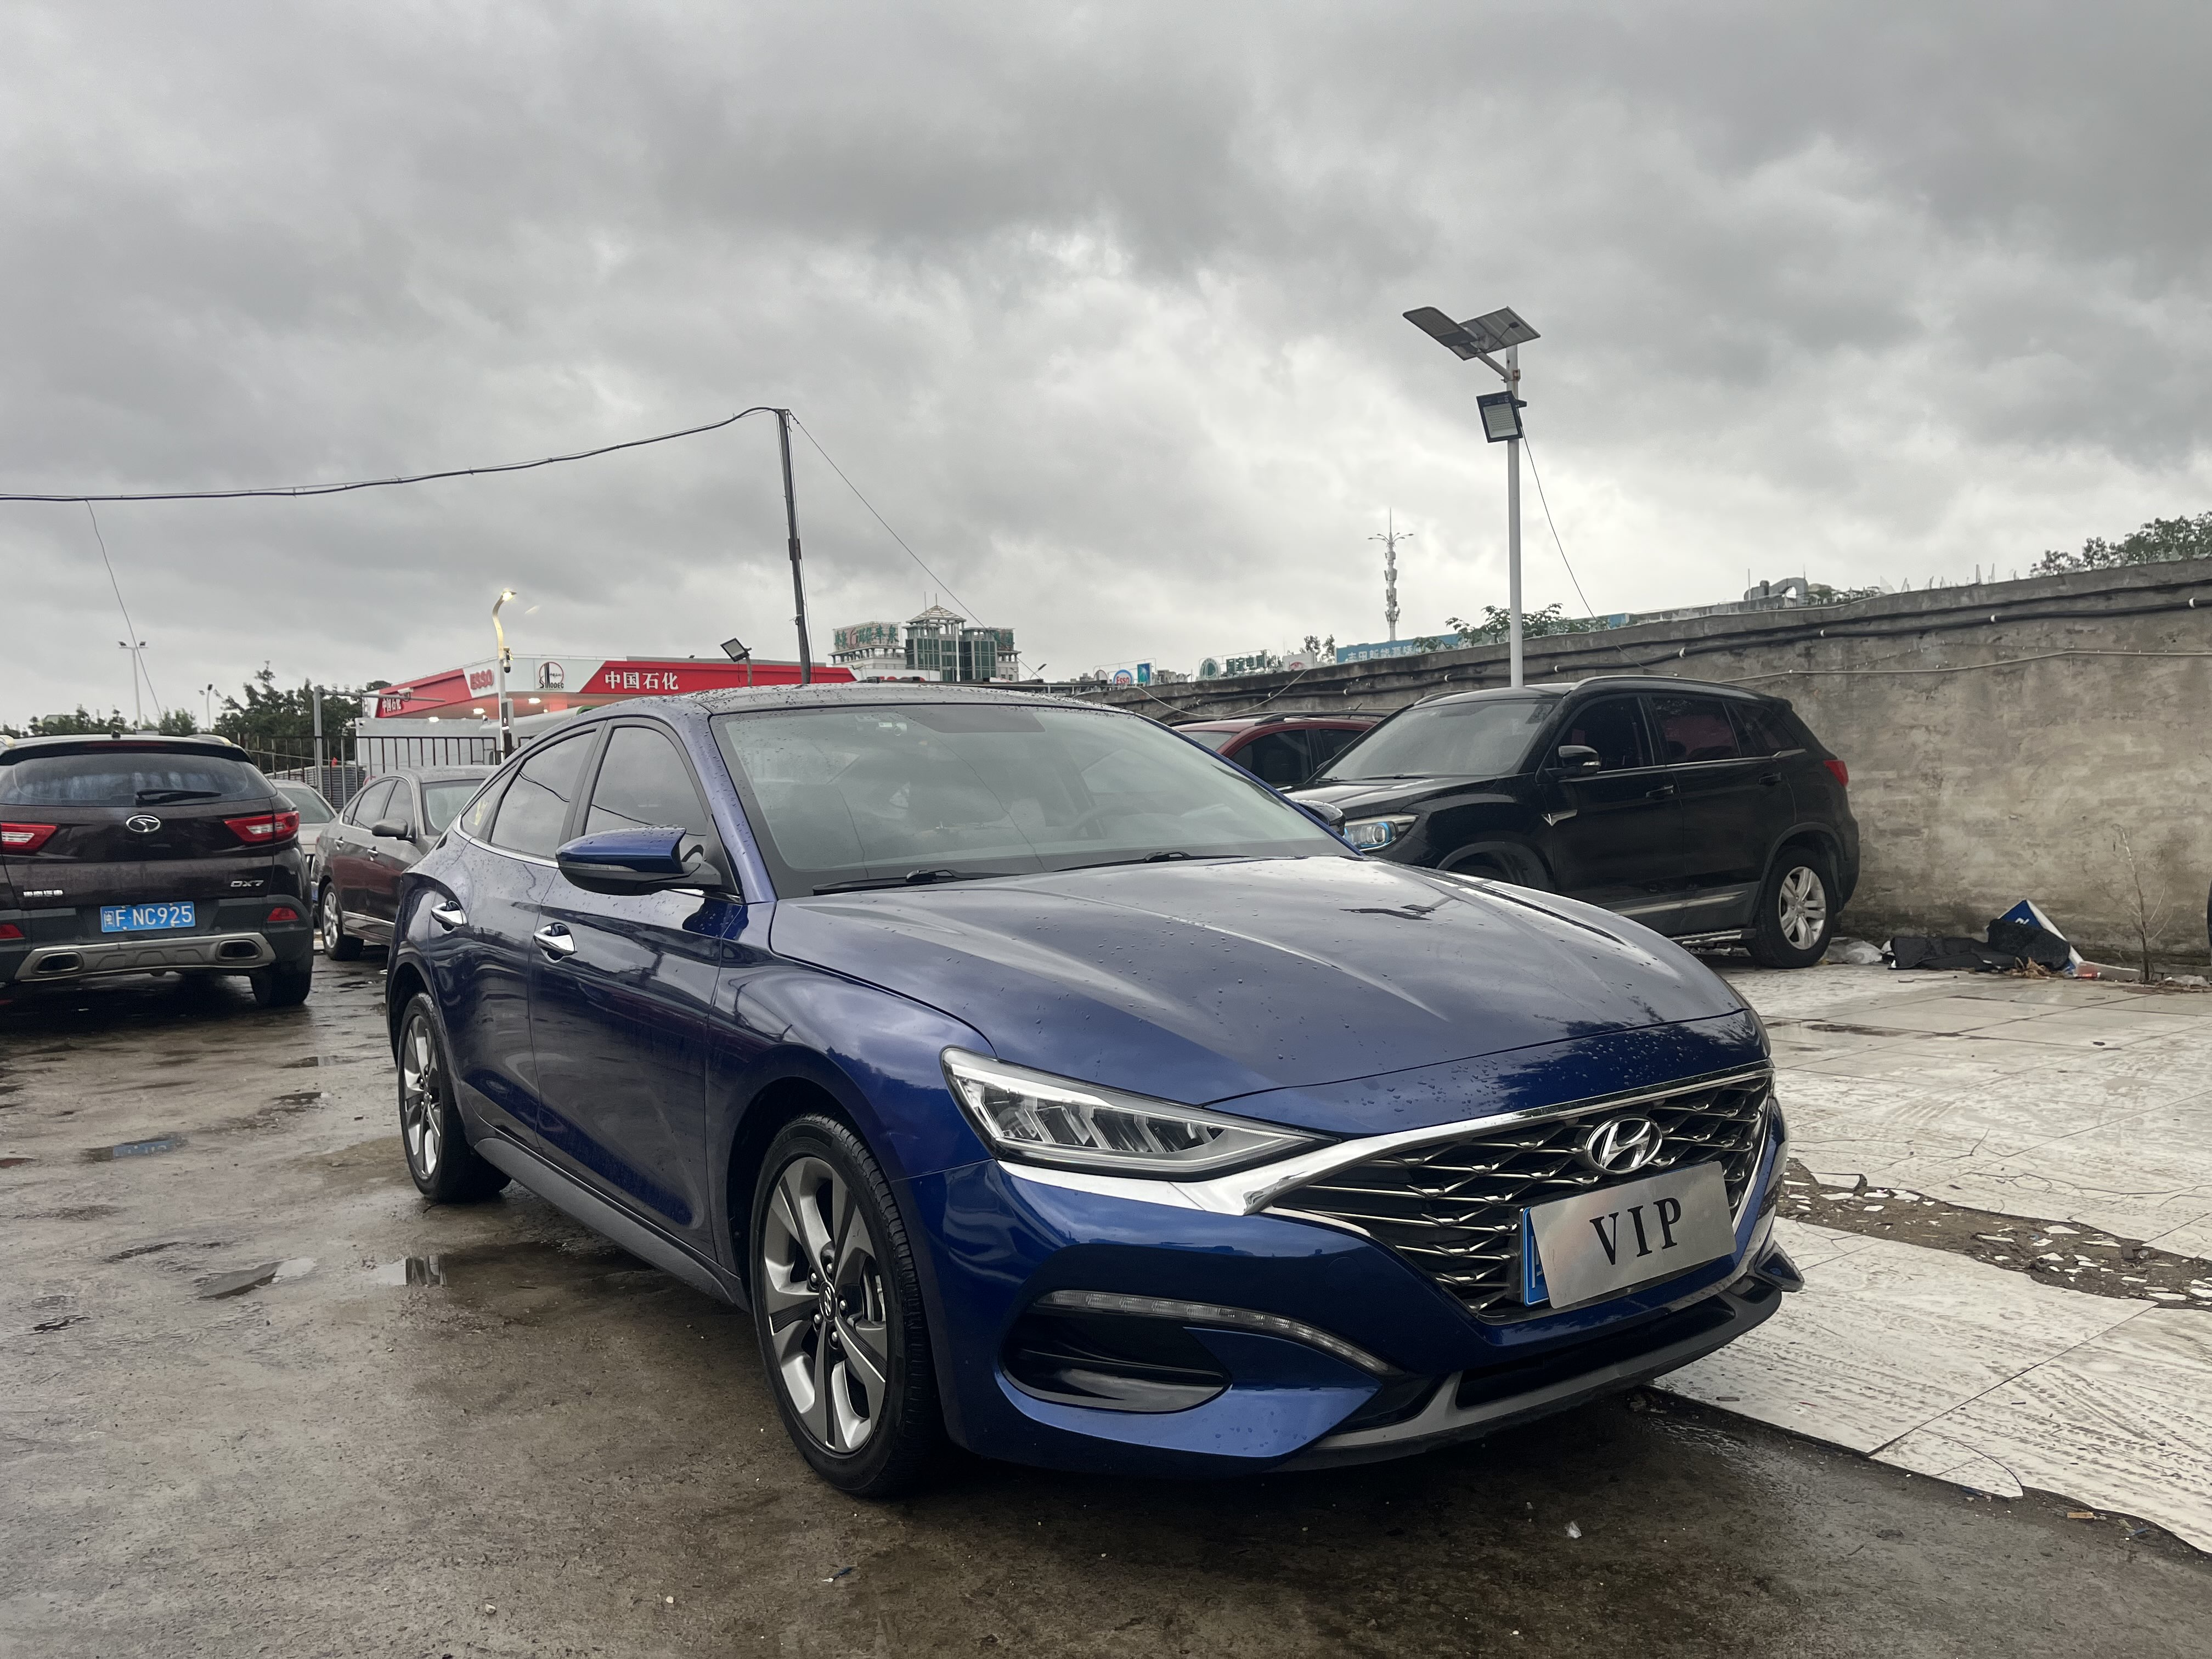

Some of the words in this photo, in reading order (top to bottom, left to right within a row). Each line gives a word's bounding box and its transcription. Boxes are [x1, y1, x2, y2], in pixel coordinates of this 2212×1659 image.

[605, 671, 679, 690] 中国石化
[1589, 1197, 1681, 1266] VIP
